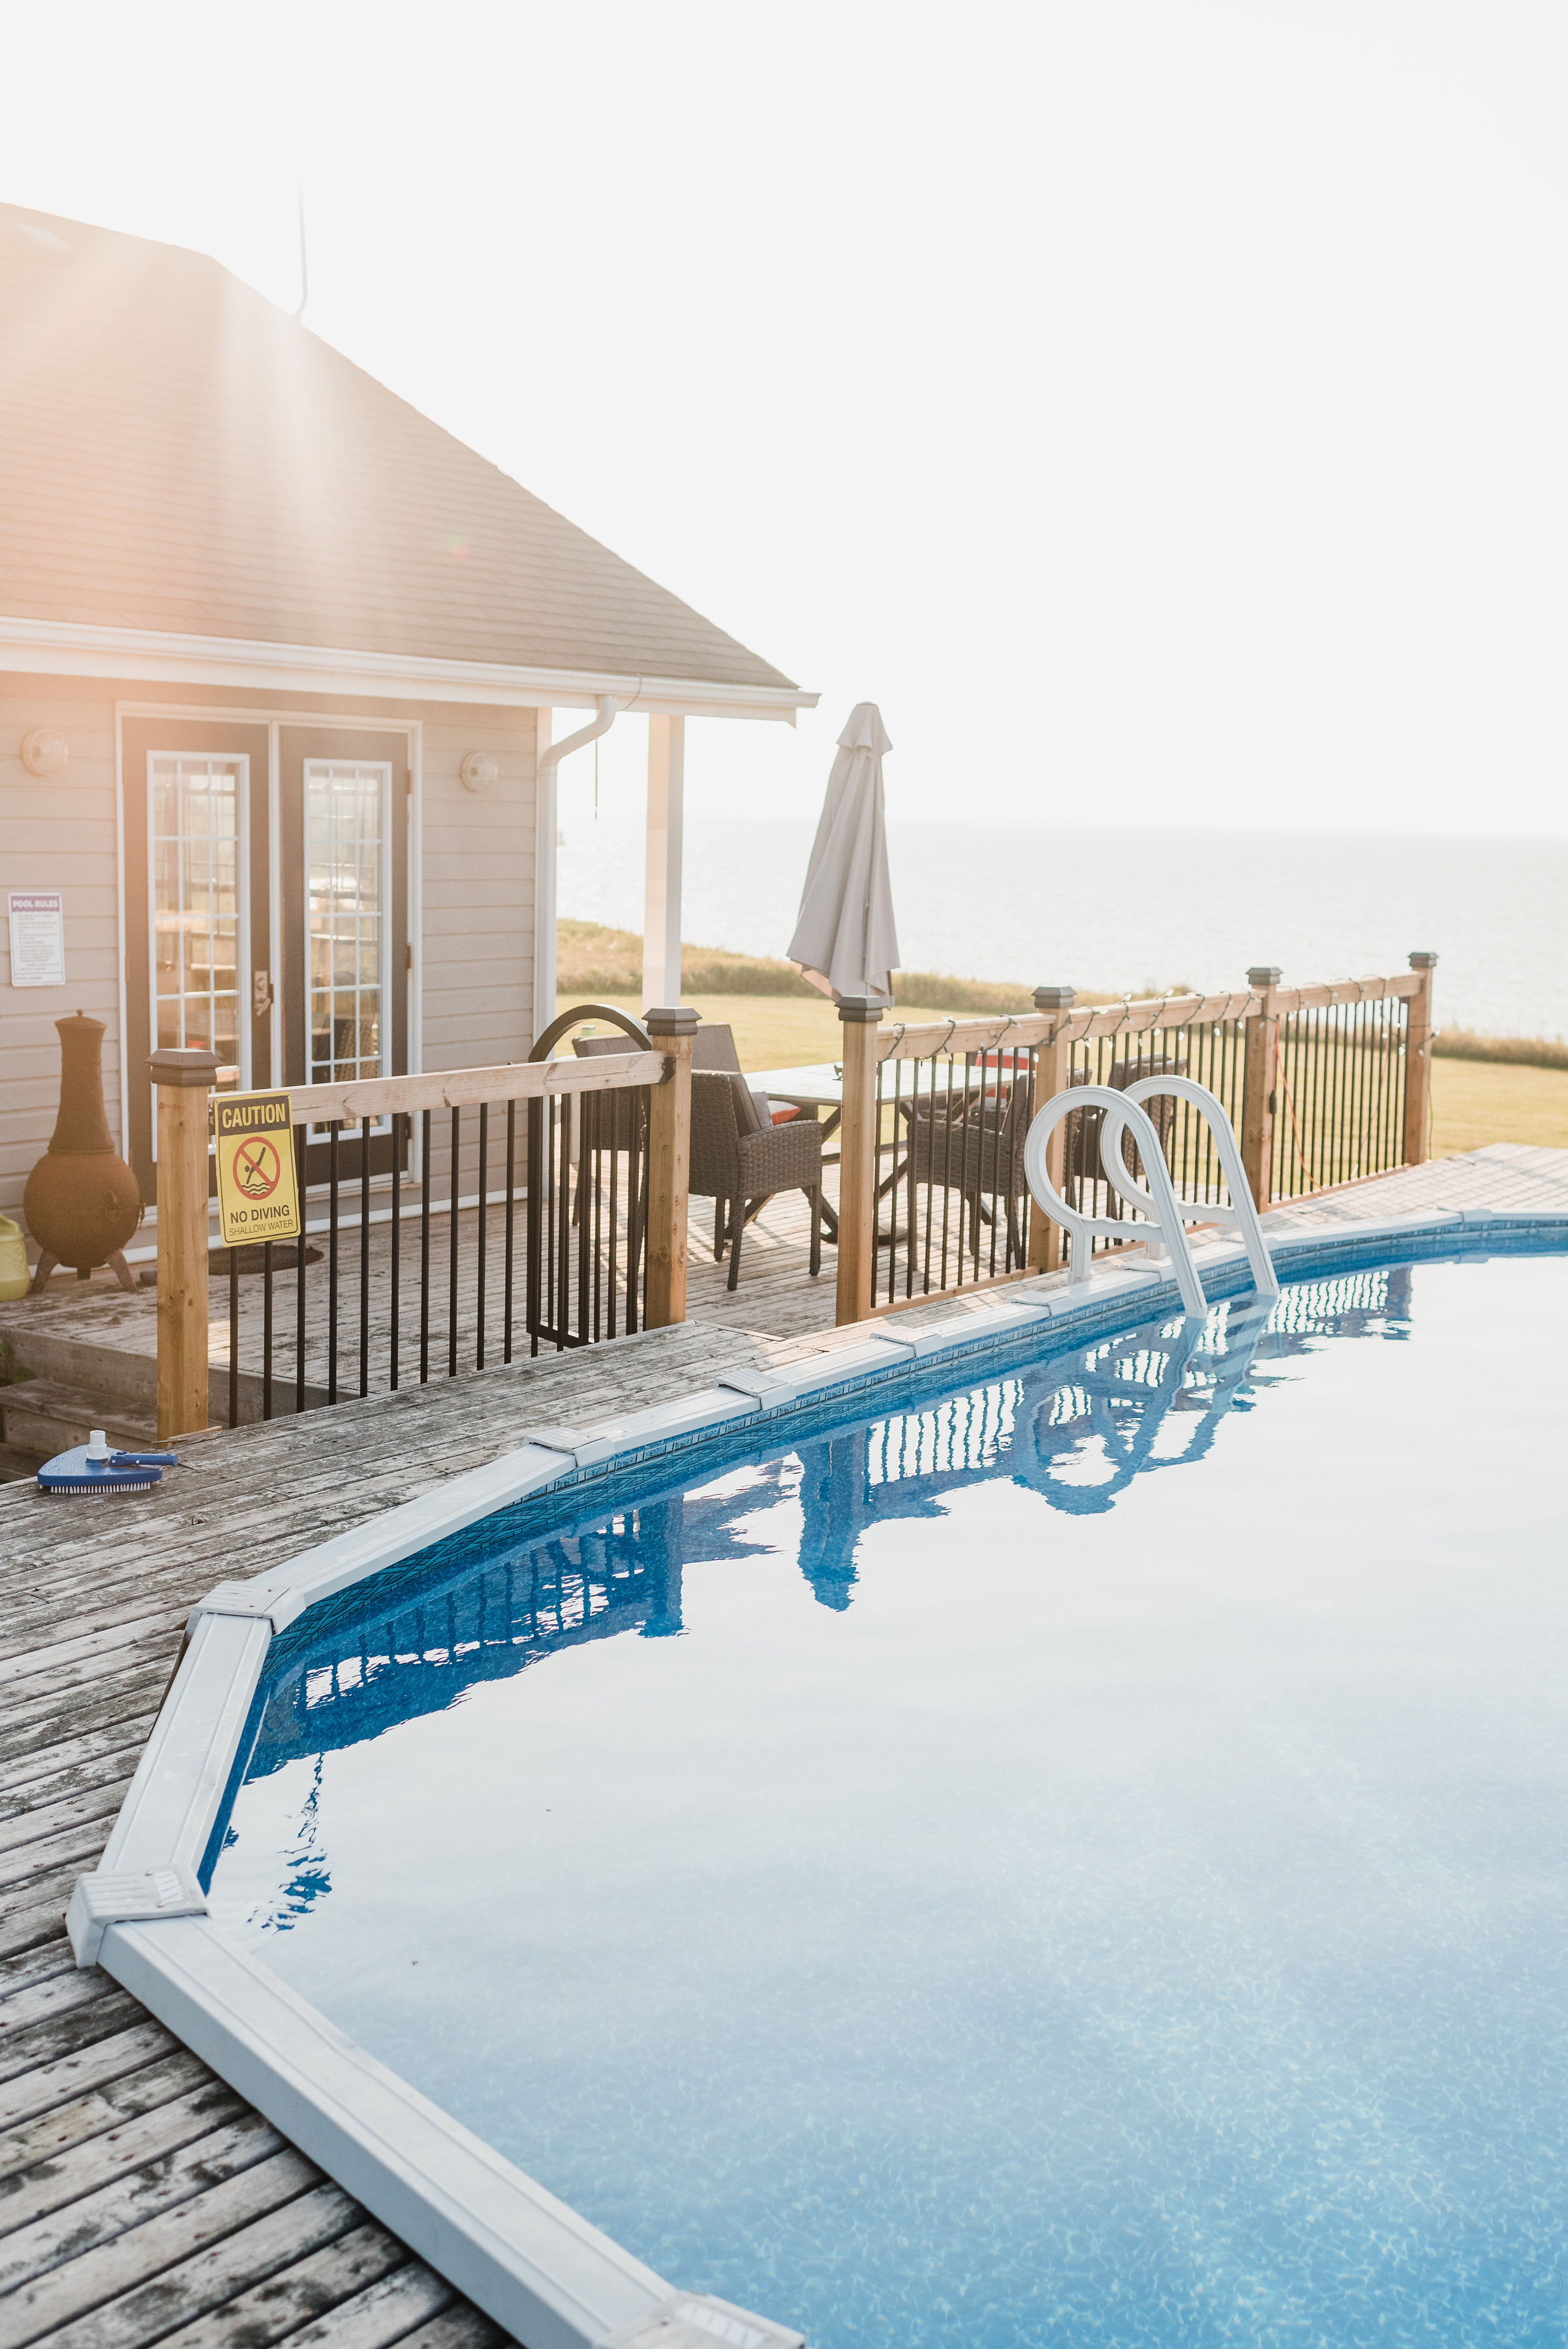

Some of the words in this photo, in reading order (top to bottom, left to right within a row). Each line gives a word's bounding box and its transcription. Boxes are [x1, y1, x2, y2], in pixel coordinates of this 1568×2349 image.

[12, 900, 34, 908] POOL
[35, 900, 58, 908] RULES
[223, 1103, 286, 1128] CAUTION
[230, 1211, 247, 1224] NO
[251, 1205, 290, 1221] DIVING
[229, 1223, 266, 1236] SHALLOW
[268, 1219, 293, 1230] WATER
